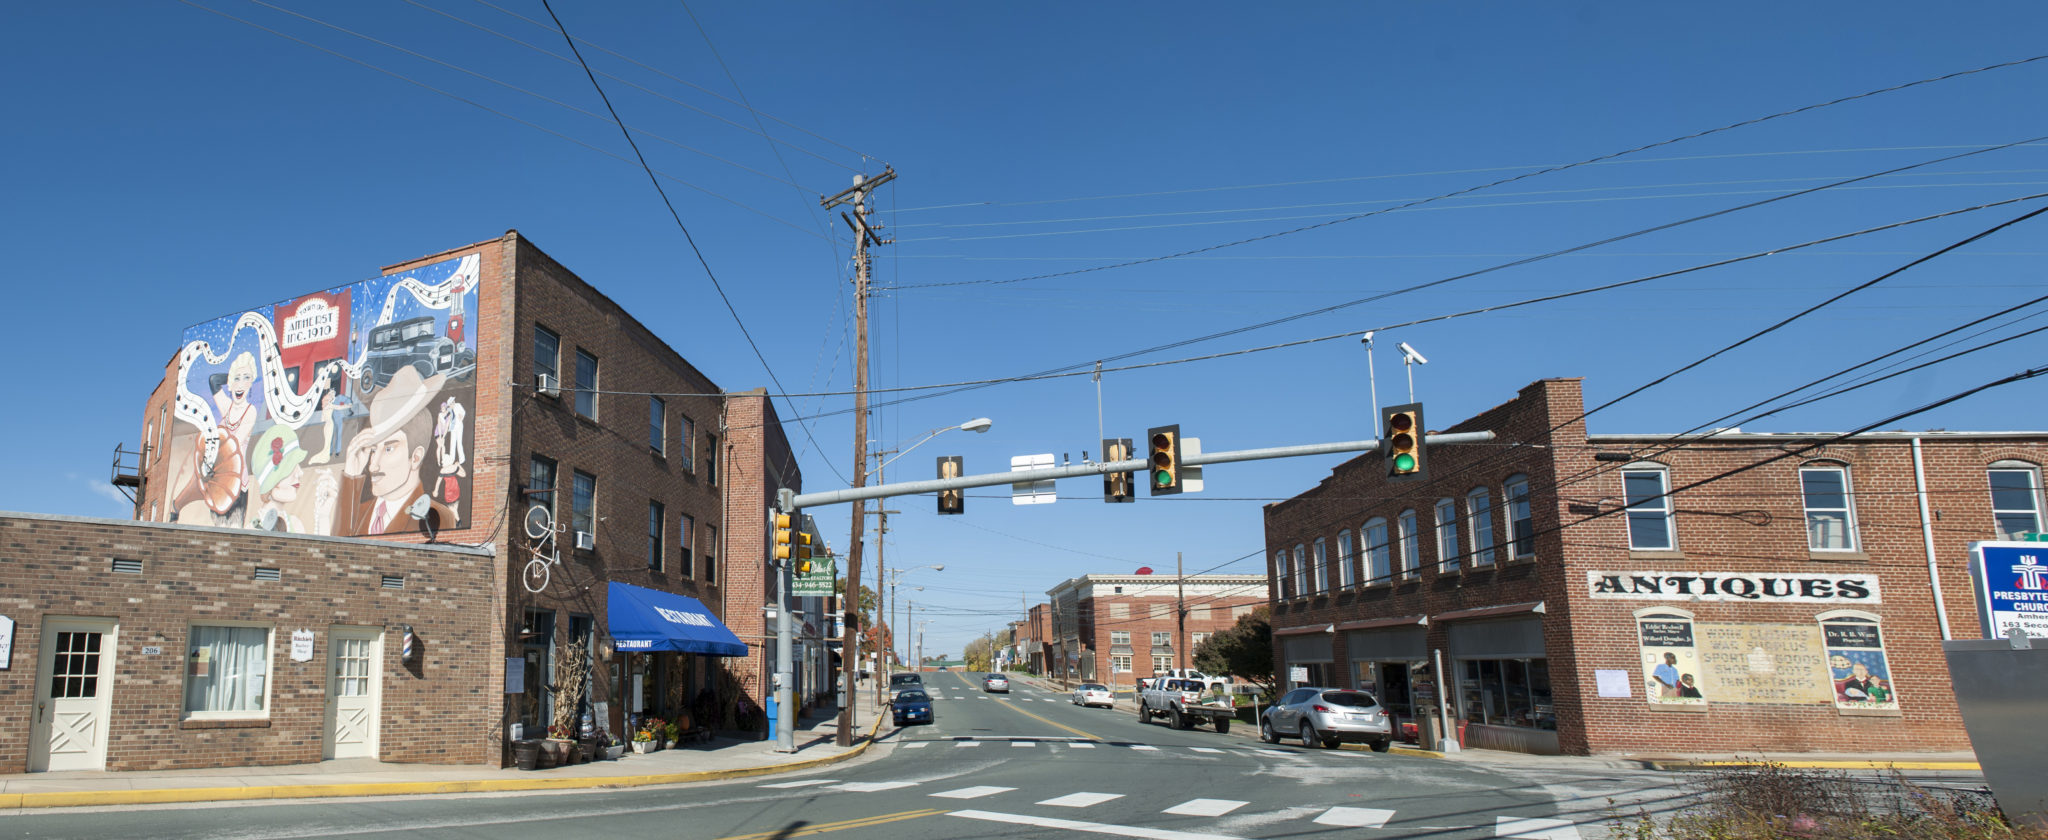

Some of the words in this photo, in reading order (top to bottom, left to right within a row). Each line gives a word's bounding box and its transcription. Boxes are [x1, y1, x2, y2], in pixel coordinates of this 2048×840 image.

[288, 312, 333, 332] AMHERST
[1594, 575, 1870, 599] ANTIQUES
[654, 606, 715, 628] RESTAURANT
[615, 640, 653, 648] RESTAURANT
